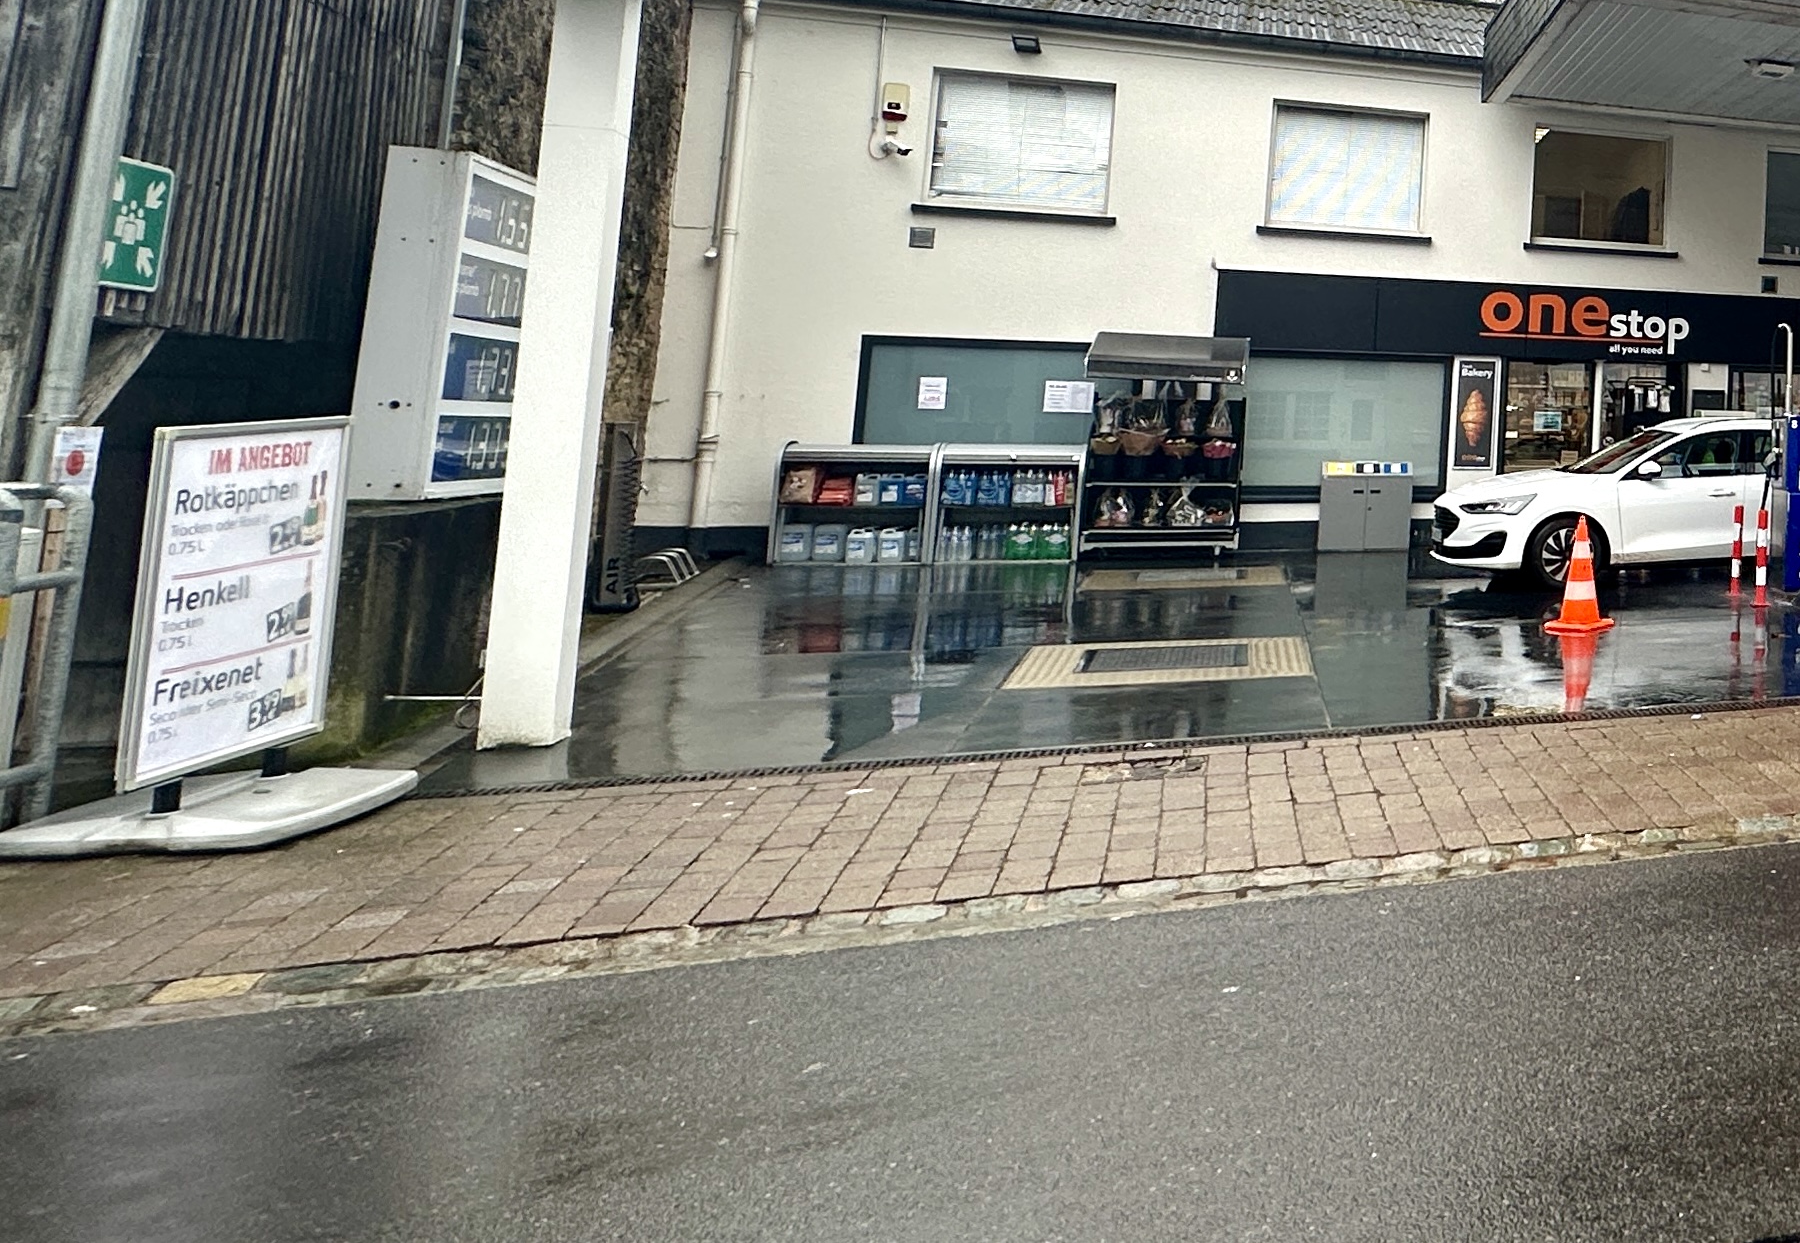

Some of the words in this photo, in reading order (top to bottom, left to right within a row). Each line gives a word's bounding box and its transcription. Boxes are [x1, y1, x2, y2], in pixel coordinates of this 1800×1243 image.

[1480, 291, 1610, 336] one
[1609, 309, 1690, 355] stop
[1609, 344, 1621, 354] all
[1621, 346, 1639, 356] you
[1640, 346, 1664, 355] need
[1461, 368, 1493, 380] Bakery
[208, 448, 233, 475] IM
[238, 441, 313, 472] ANGEBOT
[174, 478, 299, 516] Rotkäppchen
[164, 574, 251, 615] Henkell
[153, 656, 263, 706] Freixenet
